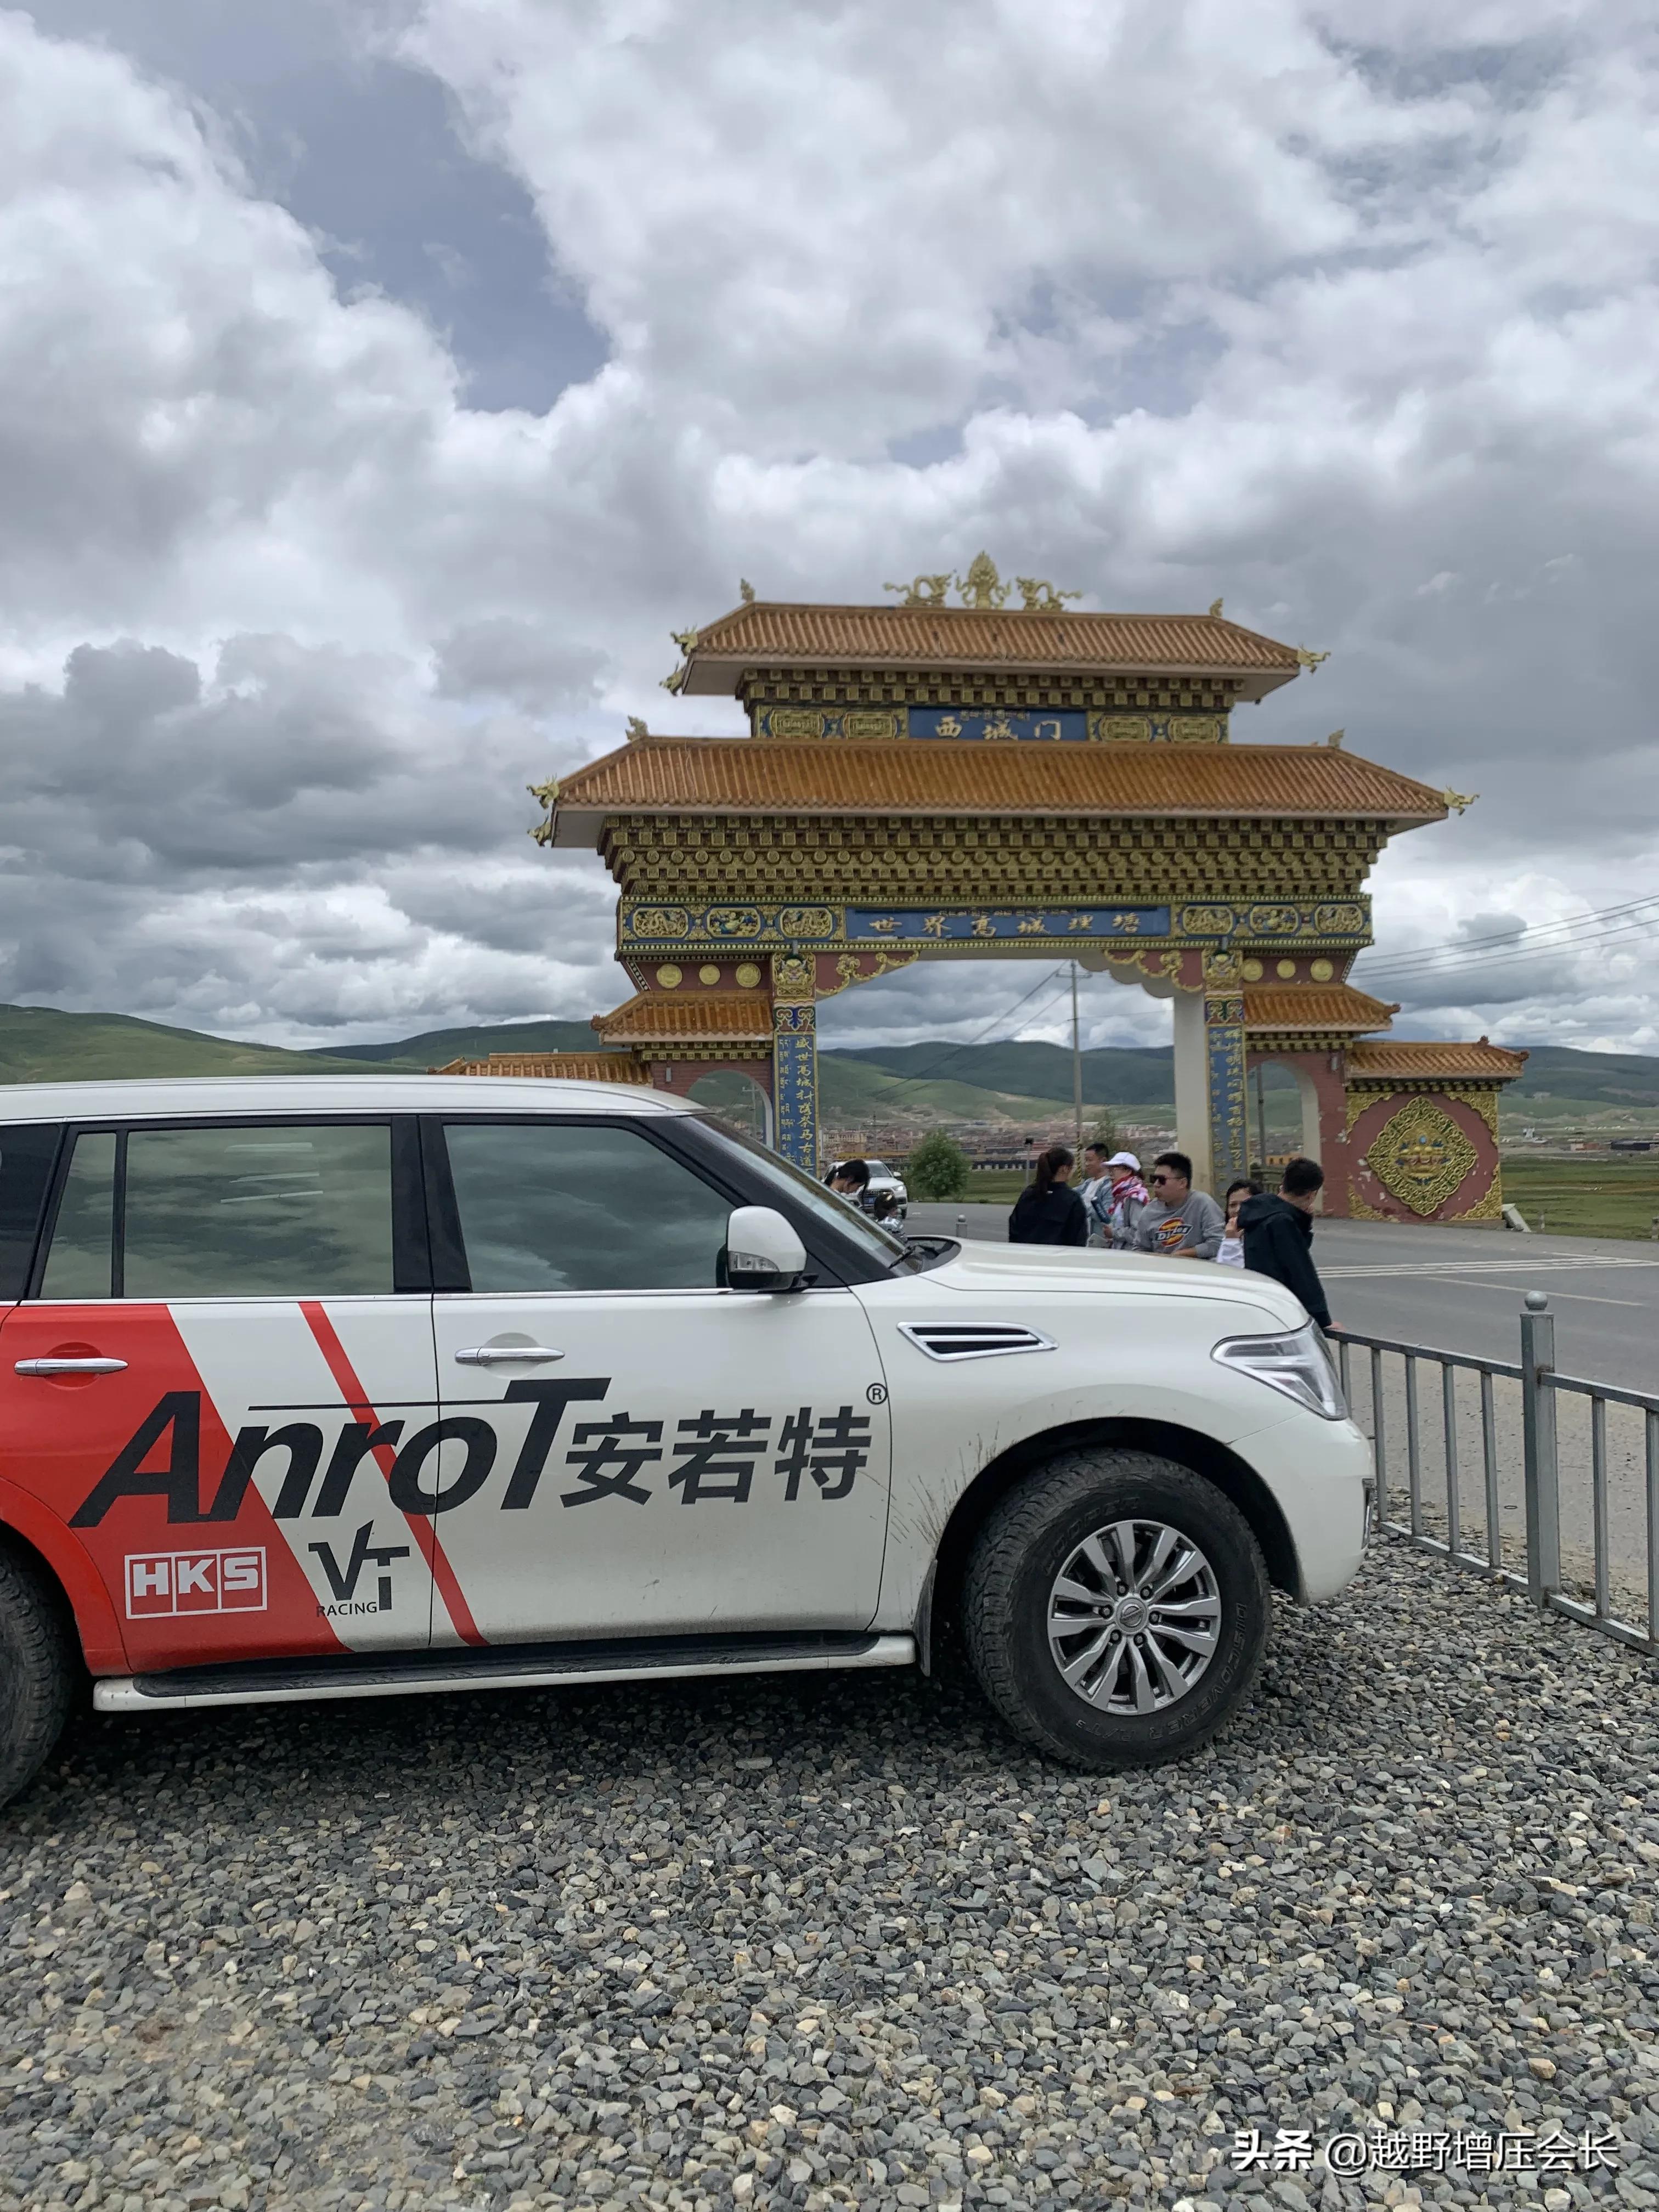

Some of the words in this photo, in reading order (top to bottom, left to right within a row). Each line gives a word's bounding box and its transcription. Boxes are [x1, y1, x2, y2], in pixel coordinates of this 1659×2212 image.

[935, 716, 1062, 741] 西城门
[869, 913, 1141, 938] 世界高城理塘
[560, 1406, 872, 1508] 安若特
[132, 1555, 259, 1597] HKS
[316, 1601, 378, 1618] RACING
